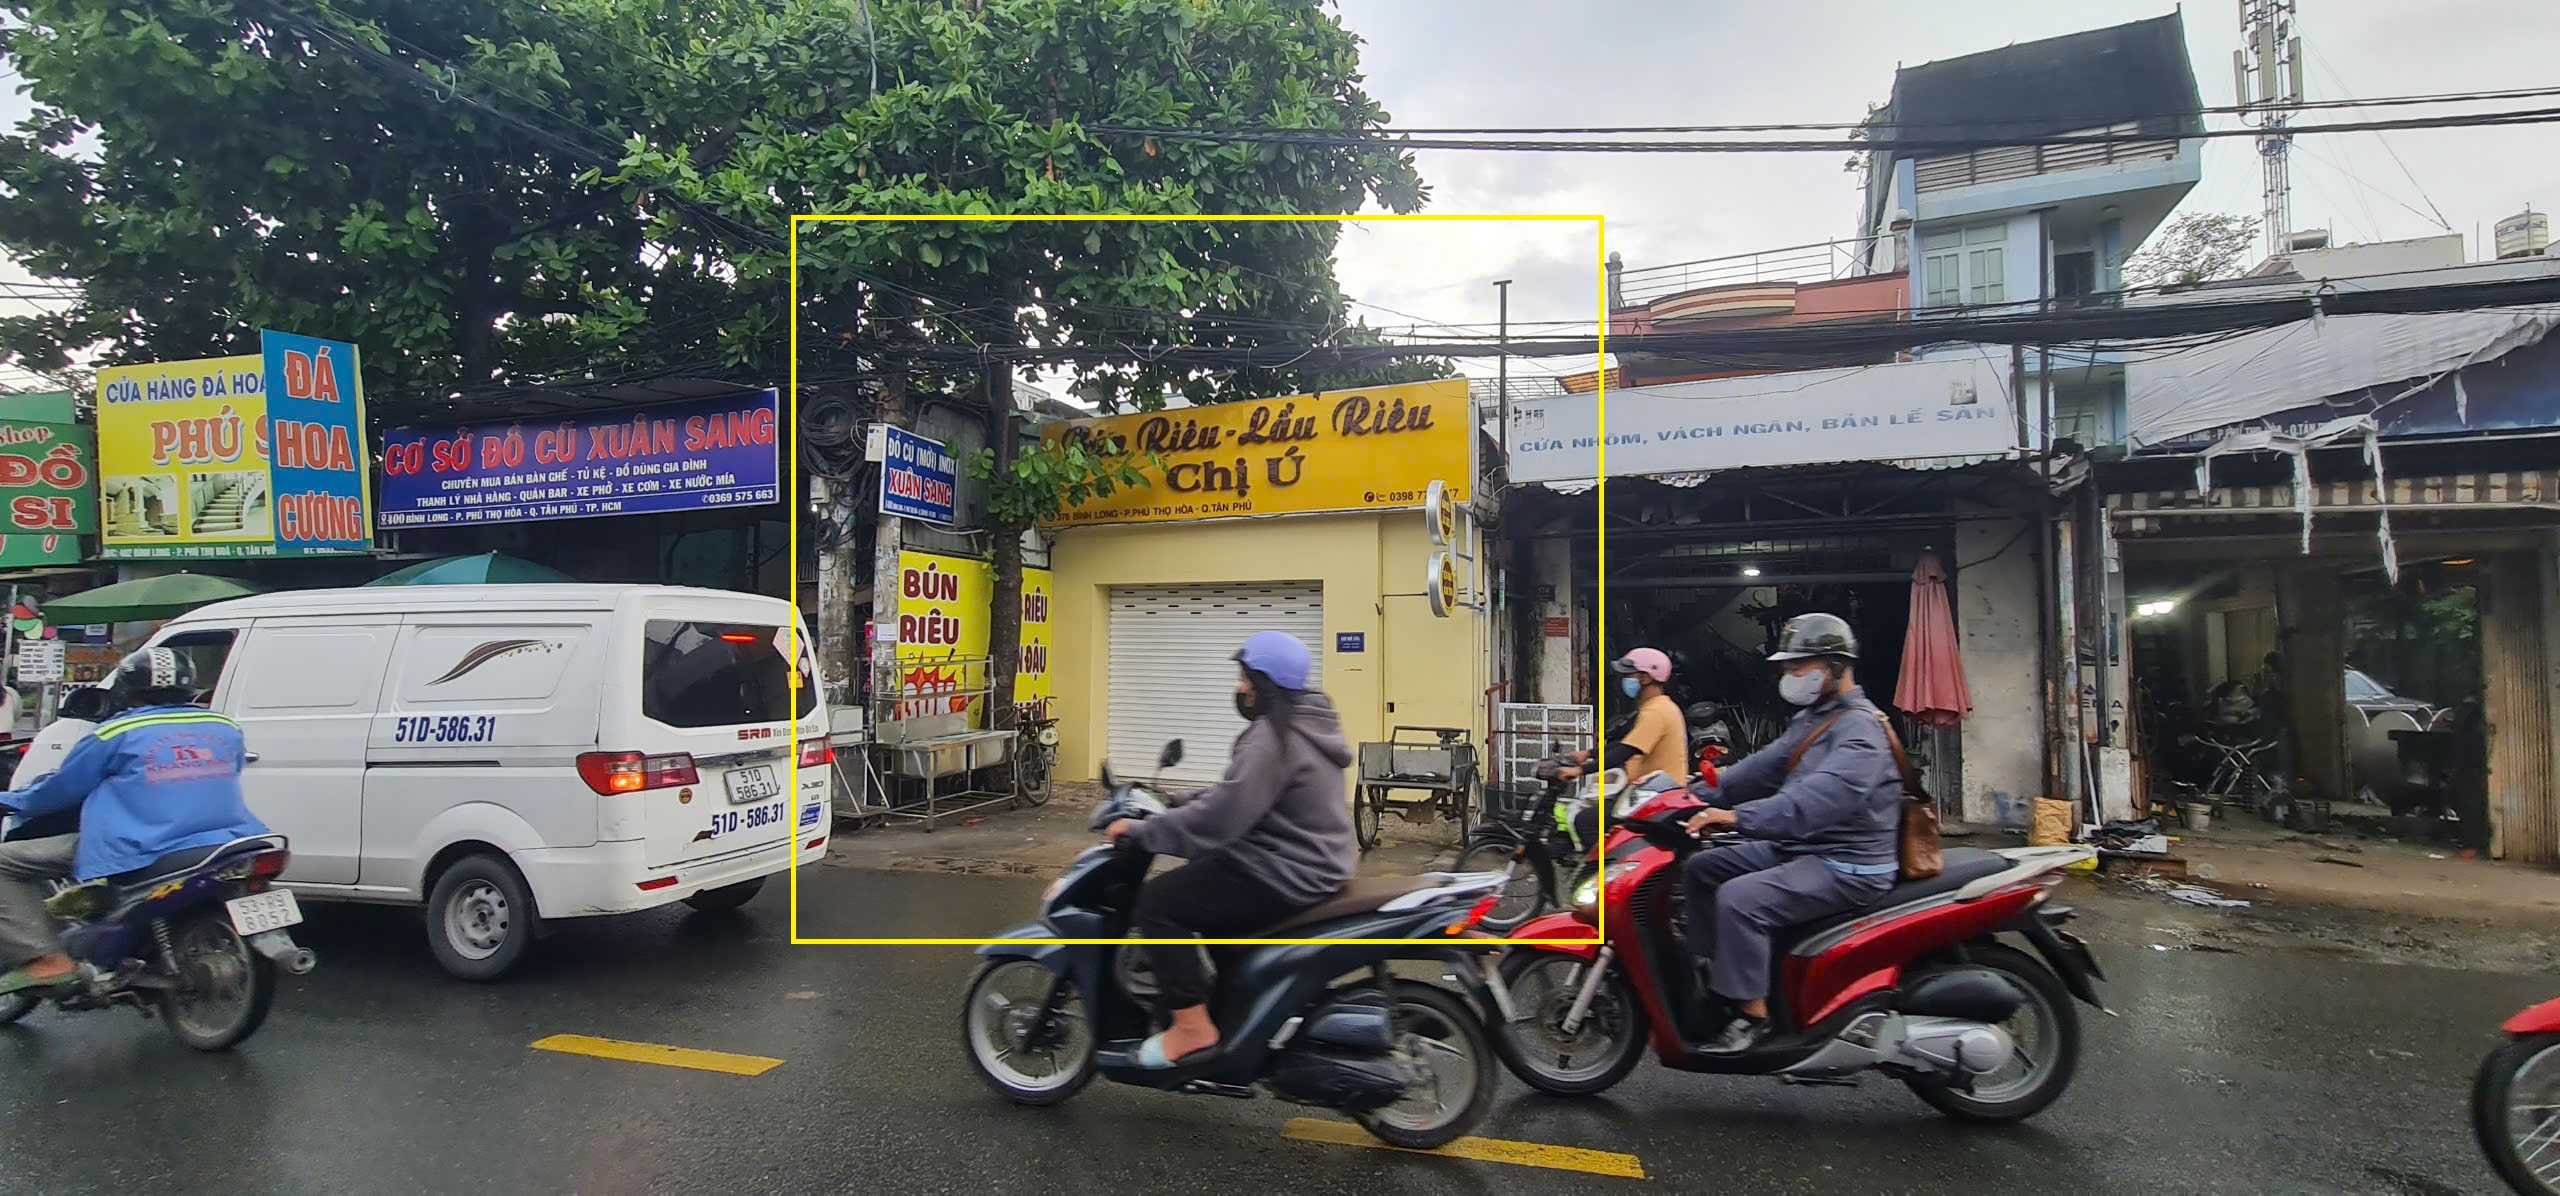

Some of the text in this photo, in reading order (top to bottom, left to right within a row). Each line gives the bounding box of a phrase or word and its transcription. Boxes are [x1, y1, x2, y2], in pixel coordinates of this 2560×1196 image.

[106, 376, 141, 403] CỬA
[147, 374, 197, 400] HÀNG
[202, 369, 227, 396] ĐÁ
[286, 347, 339, 402] ĐÁ
[151, 405, 242, 462] PHÚ
[1332, 396, 1435, 437] Riêu
[1657, 426, 1722, 441] VÁCH
[277, 421, 354, 470] HOA
[385, 408, 774, 476] CƠ SỞ ĐỒ CŨ XUÂN SANG
[416, 472, 735, 508] THANH LÝ NHÀ HÀNG QUÁN BAR XE PHỞ XE CƠM XE NƯỚC MÍA
[442, 476, 479, 490] CHUYÊN
[481, 476, 501, 488] MUA
[504, 472, 523, 486] BÁN
[526, 470, 546, 484] BÀN
[549, 467, 567, 482] GHẾ
[577, 466, 590, 480] TỦ
[593, 466, 606, 481] KỆ
[633, 461, 660, 475] DÙNG
[663, 461, 679, 473] GIA
[682, 457, 707, 471] ĐÌNH
[888, 466, 953, 508] XUÂN SANG
[1167, 446, 1305, 498] Chị Ú
[11, 496, 77, 529] SI
[428, 512, 449, 522] LONG
[466, 508, 483, 520] PHÚ
[485, 509, 502, 522] THỌ
[505, 507, 522, 518] HÒA
[541, 504, 558, 516] TÂN
[560, 502, 578, 514] PHÚ
[602, 501, 622, 511] HCM
[709, 491, 733, 504] 0369
[735, 490, 753, 502] 575
[755, 489, 774, 500] 663
[1094, 509, 1118, 519] LONG
[1154, 506, 1172, 517] THỌ
[1175, 502, 1194, 514] HÒA
[1232, 499, 1252, 511] PHÚ
[1390, 491, 1414, 502] 0398
[280, 490, 363, 541] CƯƠNG
[904, 562, 958, 601] BÚN
[1024, 586, 1048, 623] RIÊU
[899, 608, 959, 645] RIÊU
[1025, 637, 1047, 681] ĐẬU
[395, 716, 496, 742] 51D-586.31
[737, 728, 771, 740] SRM
[736, 781, 773, 800] 586.31
[740, 769, 761, 784] 51D
